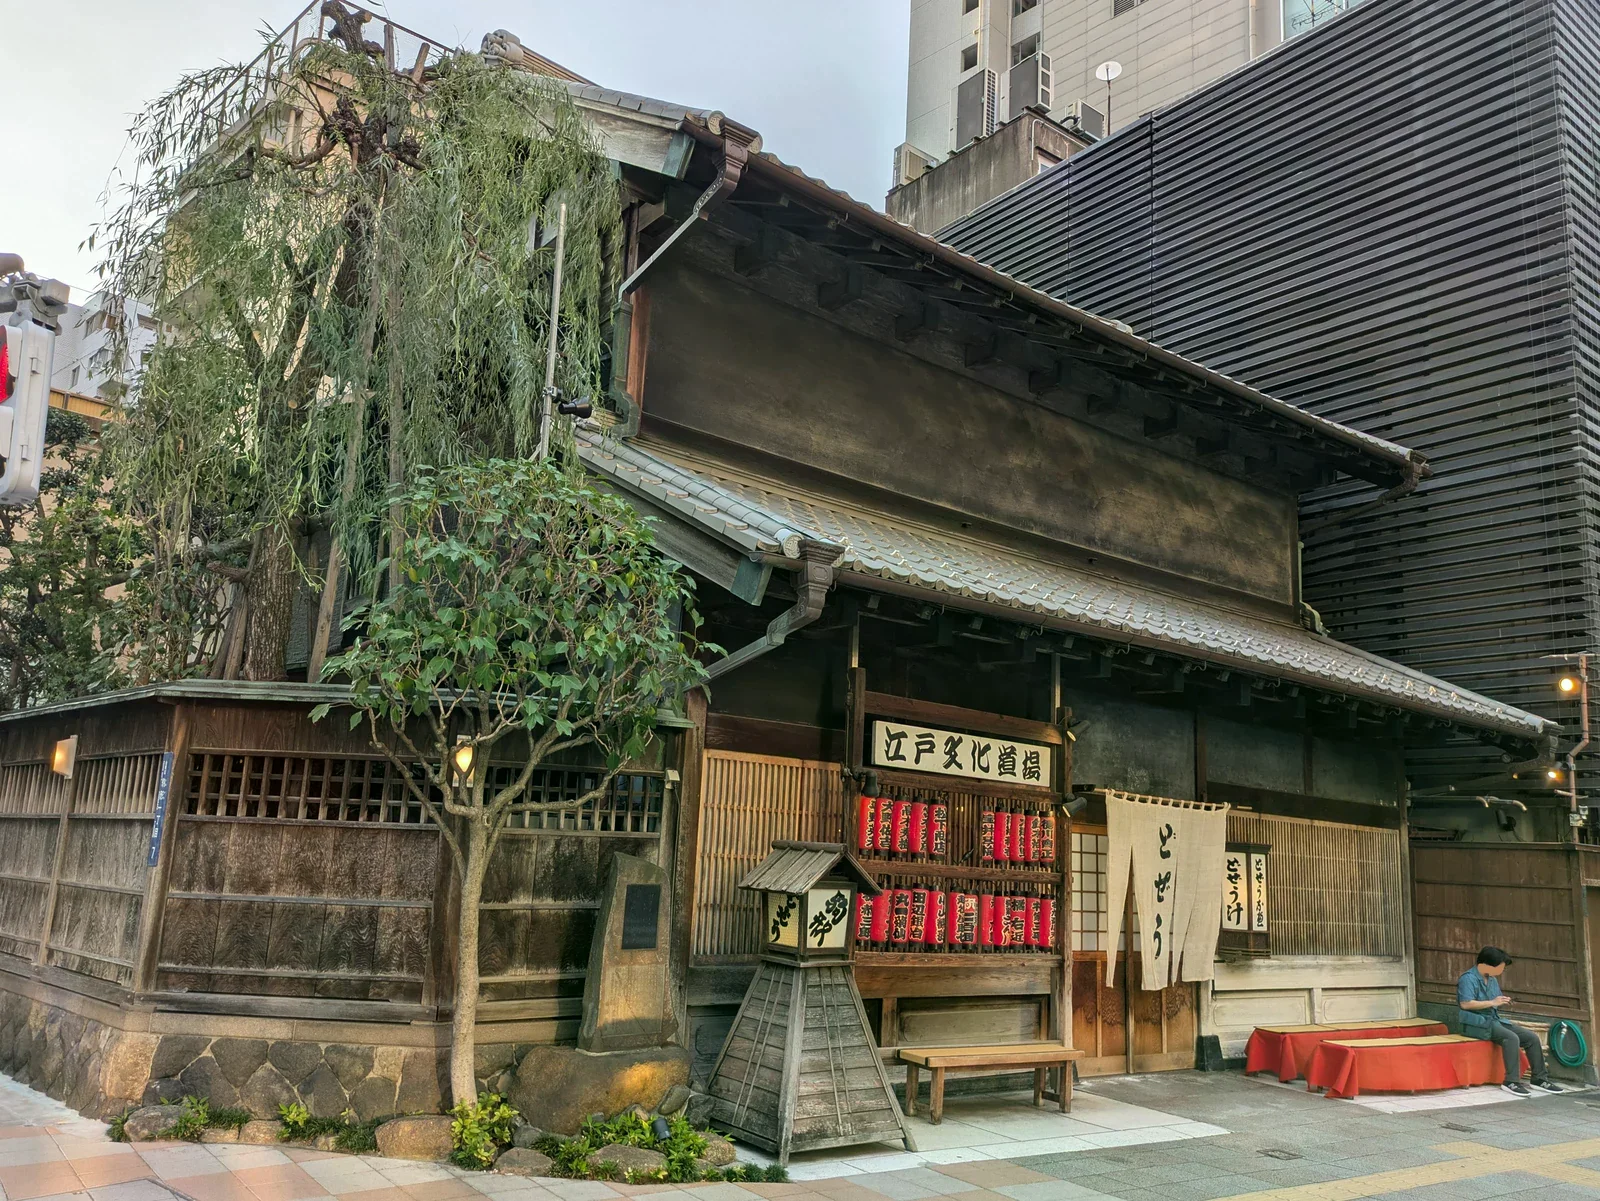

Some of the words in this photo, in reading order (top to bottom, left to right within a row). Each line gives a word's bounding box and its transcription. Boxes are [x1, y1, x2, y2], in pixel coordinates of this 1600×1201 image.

[884, 725, 1041, 781] 江戸文化道場
[1153, 823, 1177, 960] どぜう
[1226, 857, 1244, 926] どぜう汁
